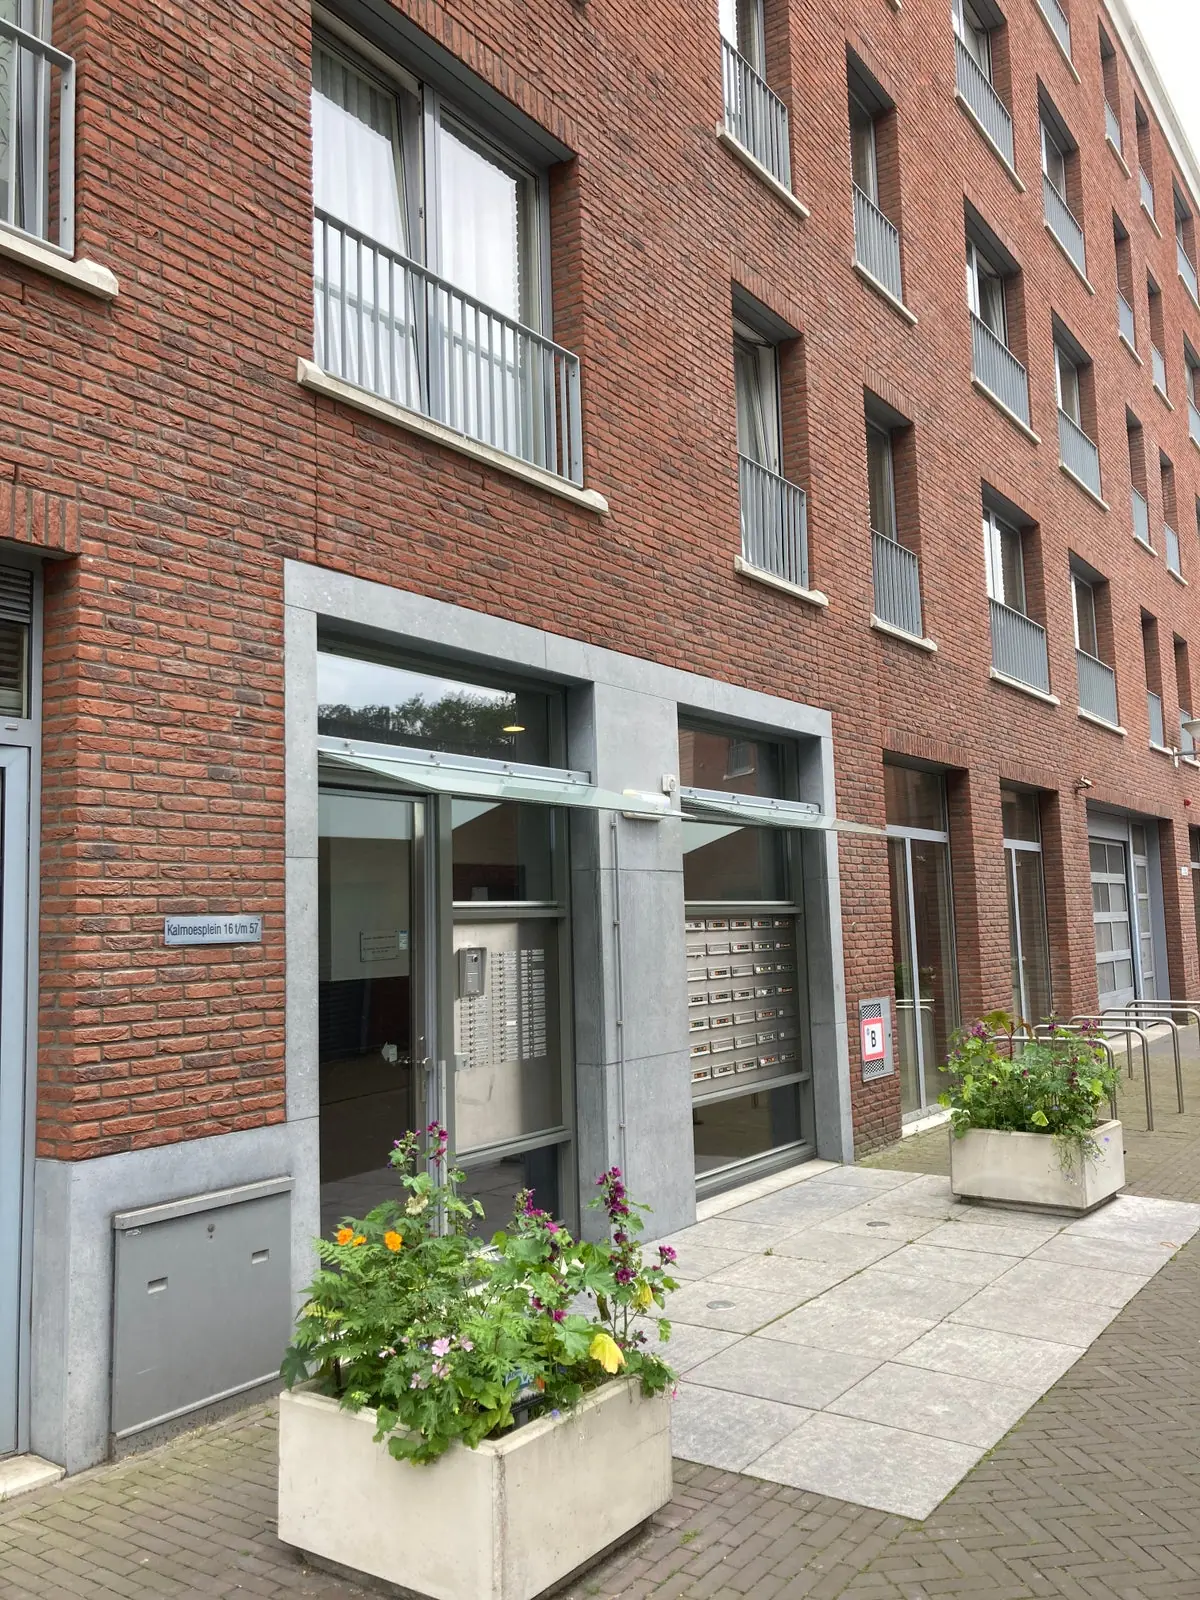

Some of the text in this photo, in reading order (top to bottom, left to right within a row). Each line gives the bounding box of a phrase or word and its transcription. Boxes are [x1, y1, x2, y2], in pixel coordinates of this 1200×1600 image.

[167, 922, 259, 937] Kalmoesplein 16 t/m 57
[871, 1030, 877, 1048] B
